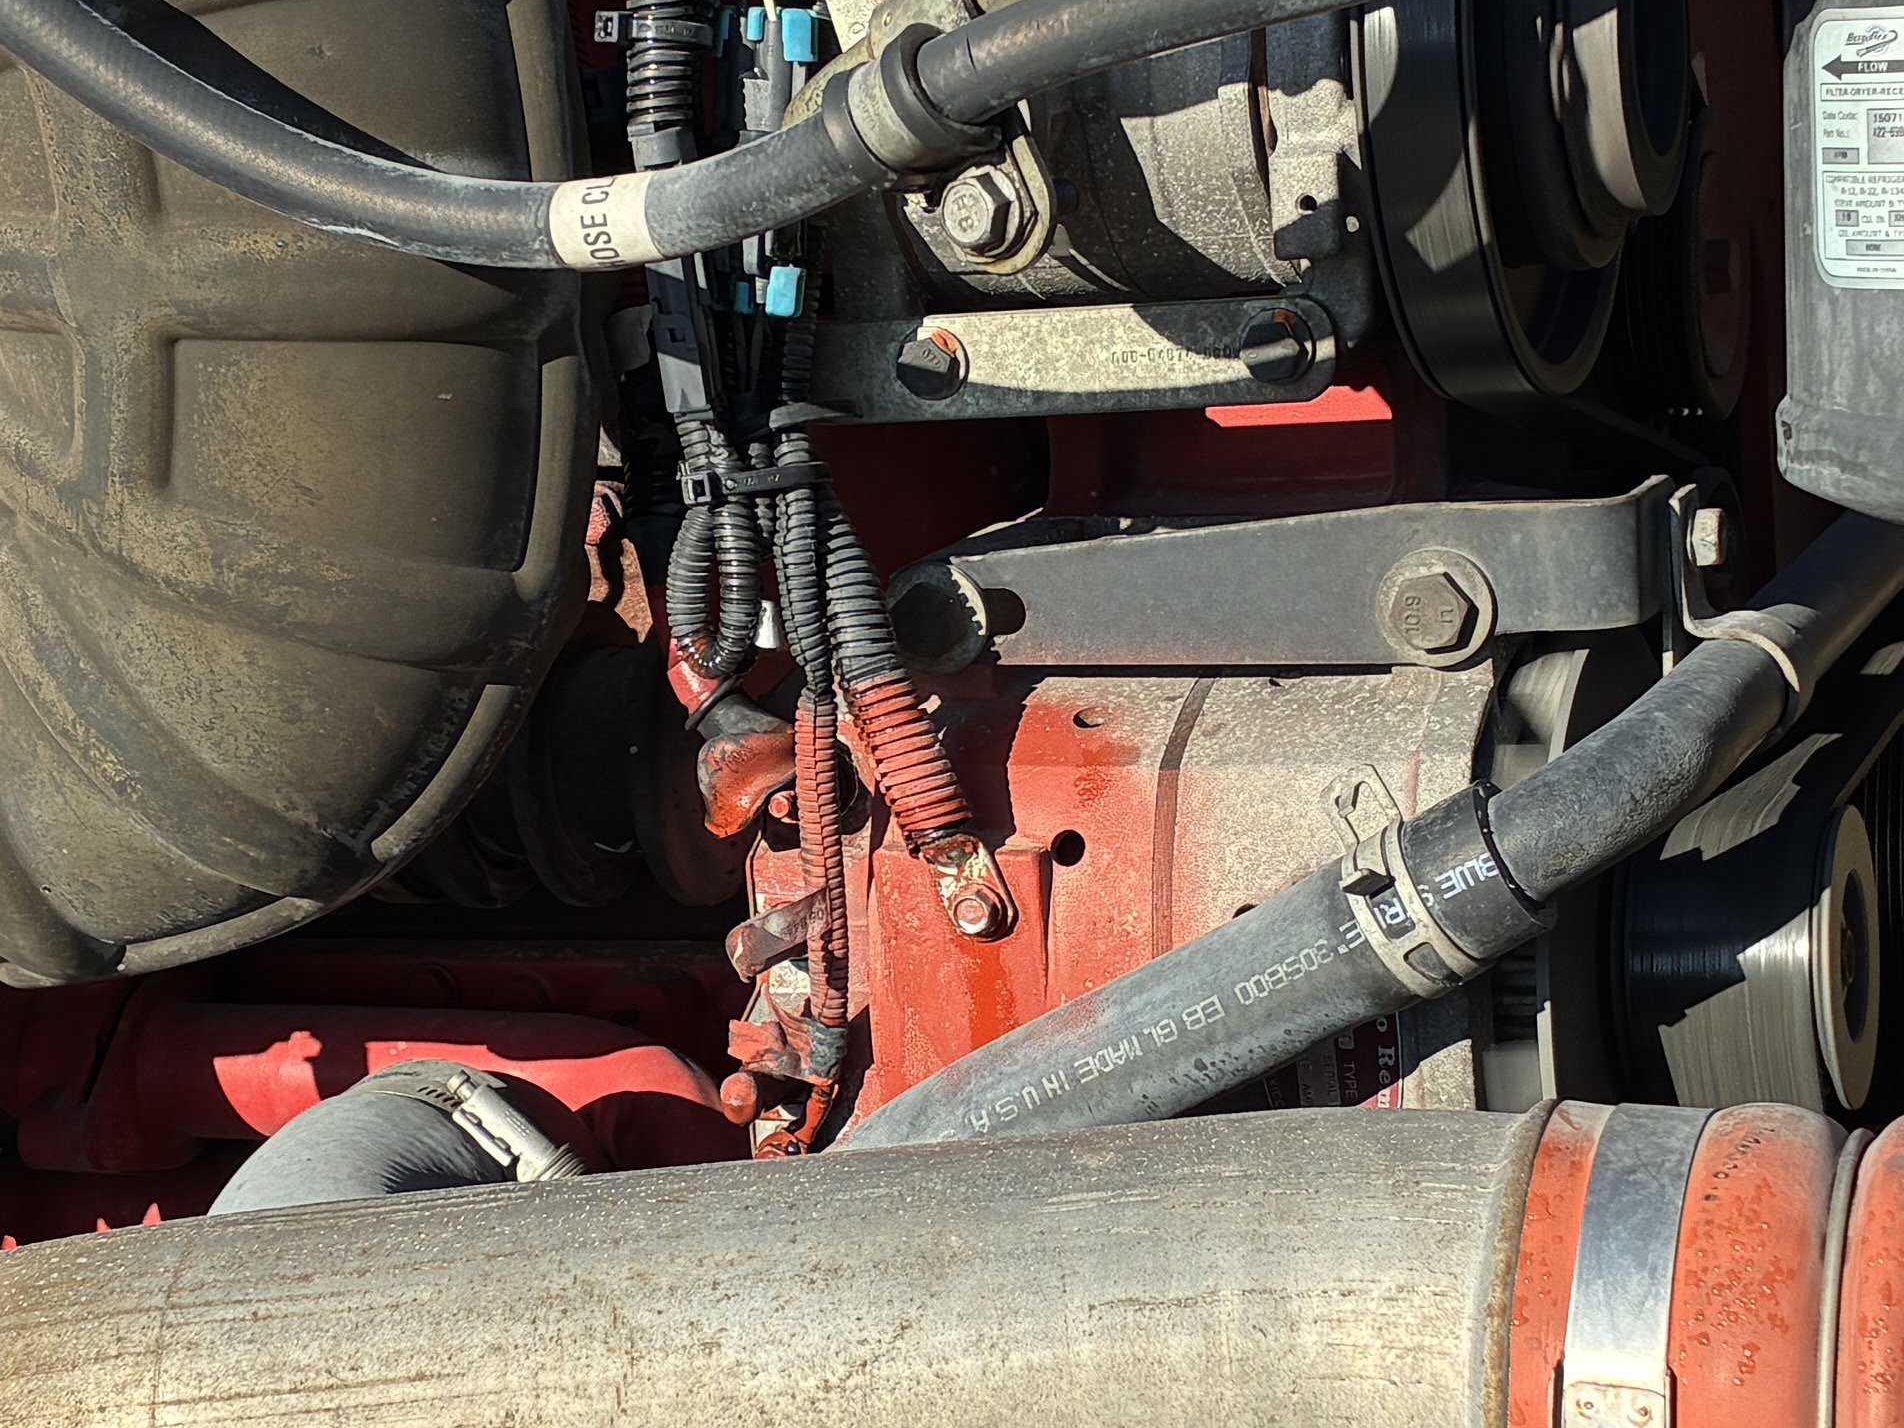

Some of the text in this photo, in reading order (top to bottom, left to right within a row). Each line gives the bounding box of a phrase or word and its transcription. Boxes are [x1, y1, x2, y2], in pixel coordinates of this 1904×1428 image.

[1857, 61, 1889, 73] FLOW
[1072, 1034, 1143, 1082] MADE
[1377, 1044, 1396, 1109] Rem
[1043, 1073, 1072, 1100] IN
